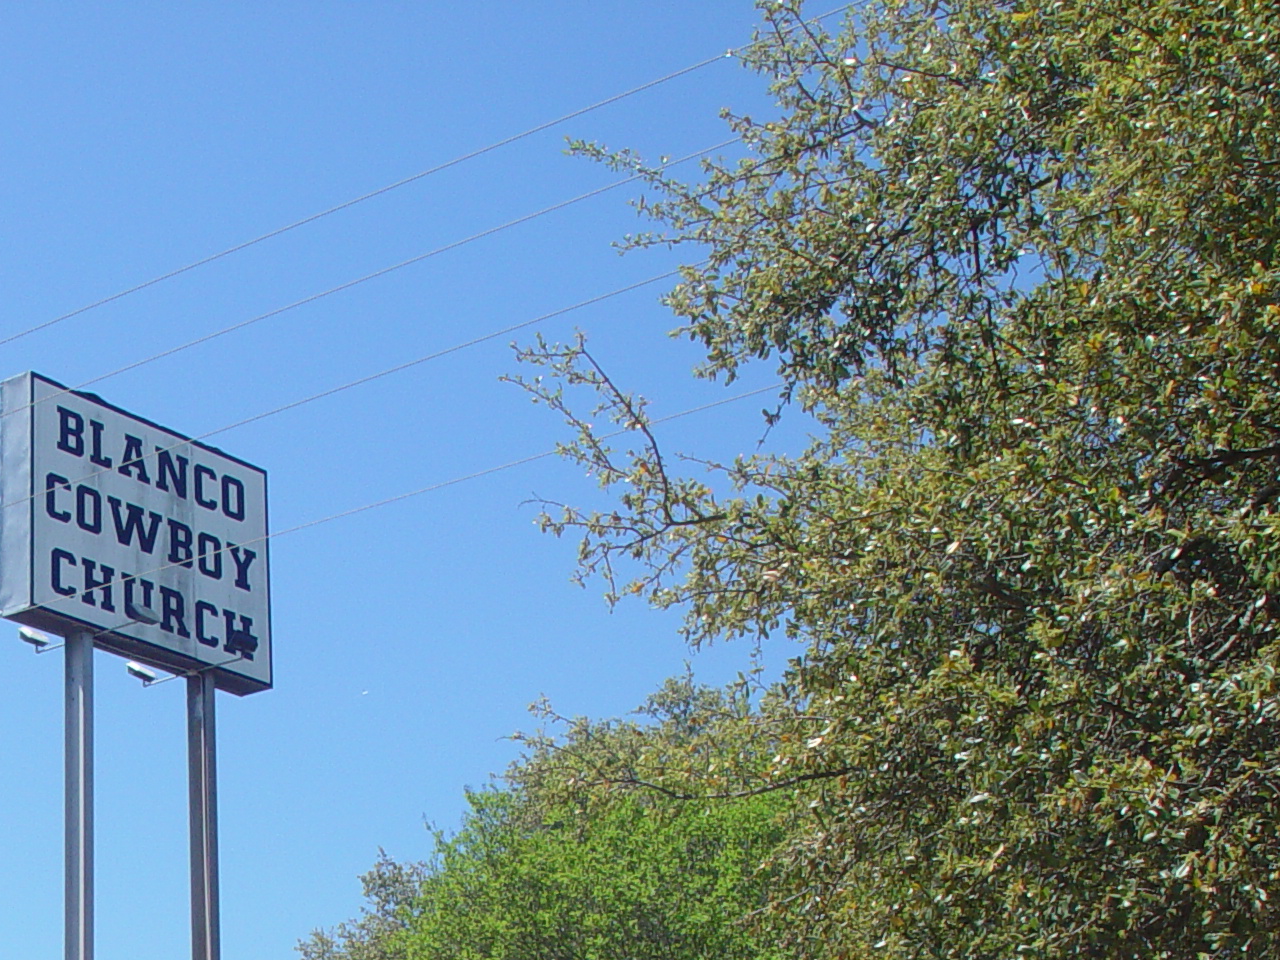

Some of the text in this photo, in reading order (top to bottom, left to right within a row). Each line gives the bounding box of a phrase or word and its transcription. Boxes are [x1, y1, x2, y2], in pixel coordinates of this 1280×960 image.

[56, 404, 245, 522] BLANCO
[45, 471, 257, 592] COWBOY
[50, 546, 254, 661] CHURCH
